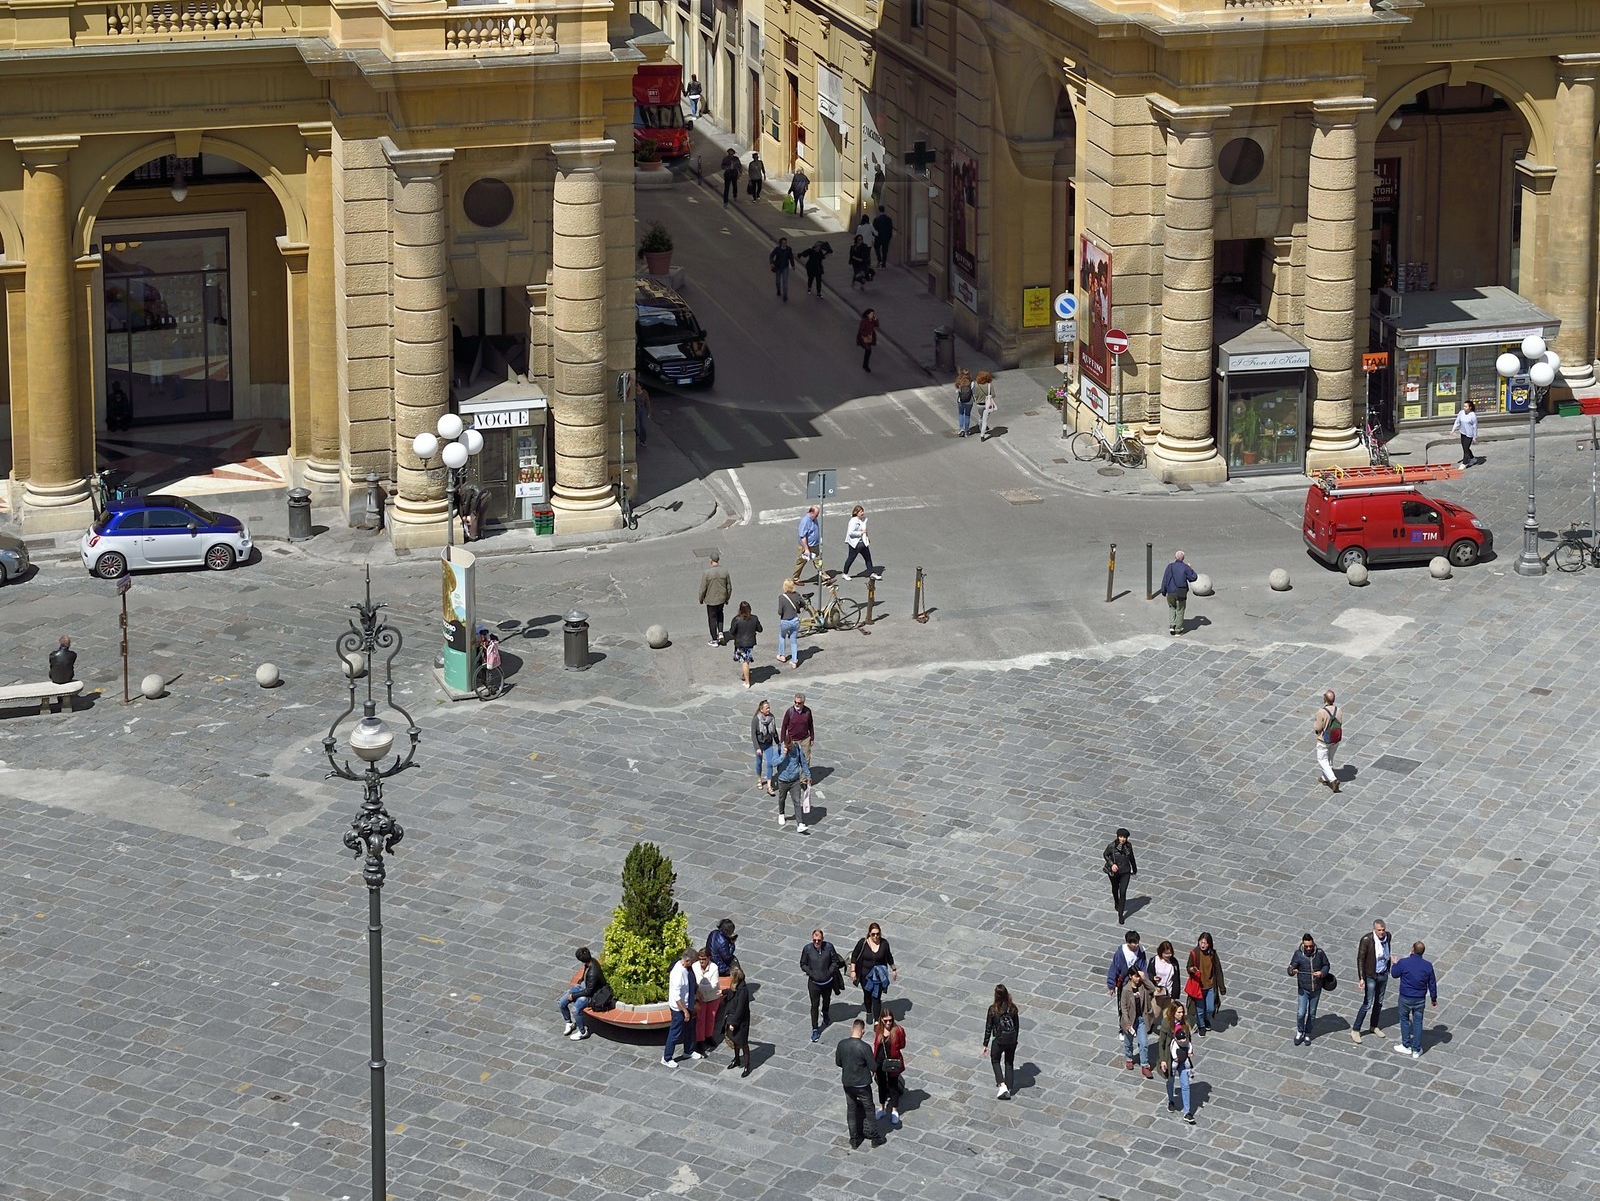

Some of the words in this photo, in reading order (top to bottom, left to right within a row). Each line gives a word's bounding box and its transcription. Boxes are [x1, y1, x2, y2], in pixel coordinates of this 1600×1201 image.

[1082, 352, 1104, 374] RUFFINO
[1243, 356, 1267, 367] Fiori
[1279, 354, 1307, 365] Katia
[1365, 357, 1386, 367] TAXI
[475, 411, 528, 428] VOGUE
[1422, 532, 1438, 541] TIM
